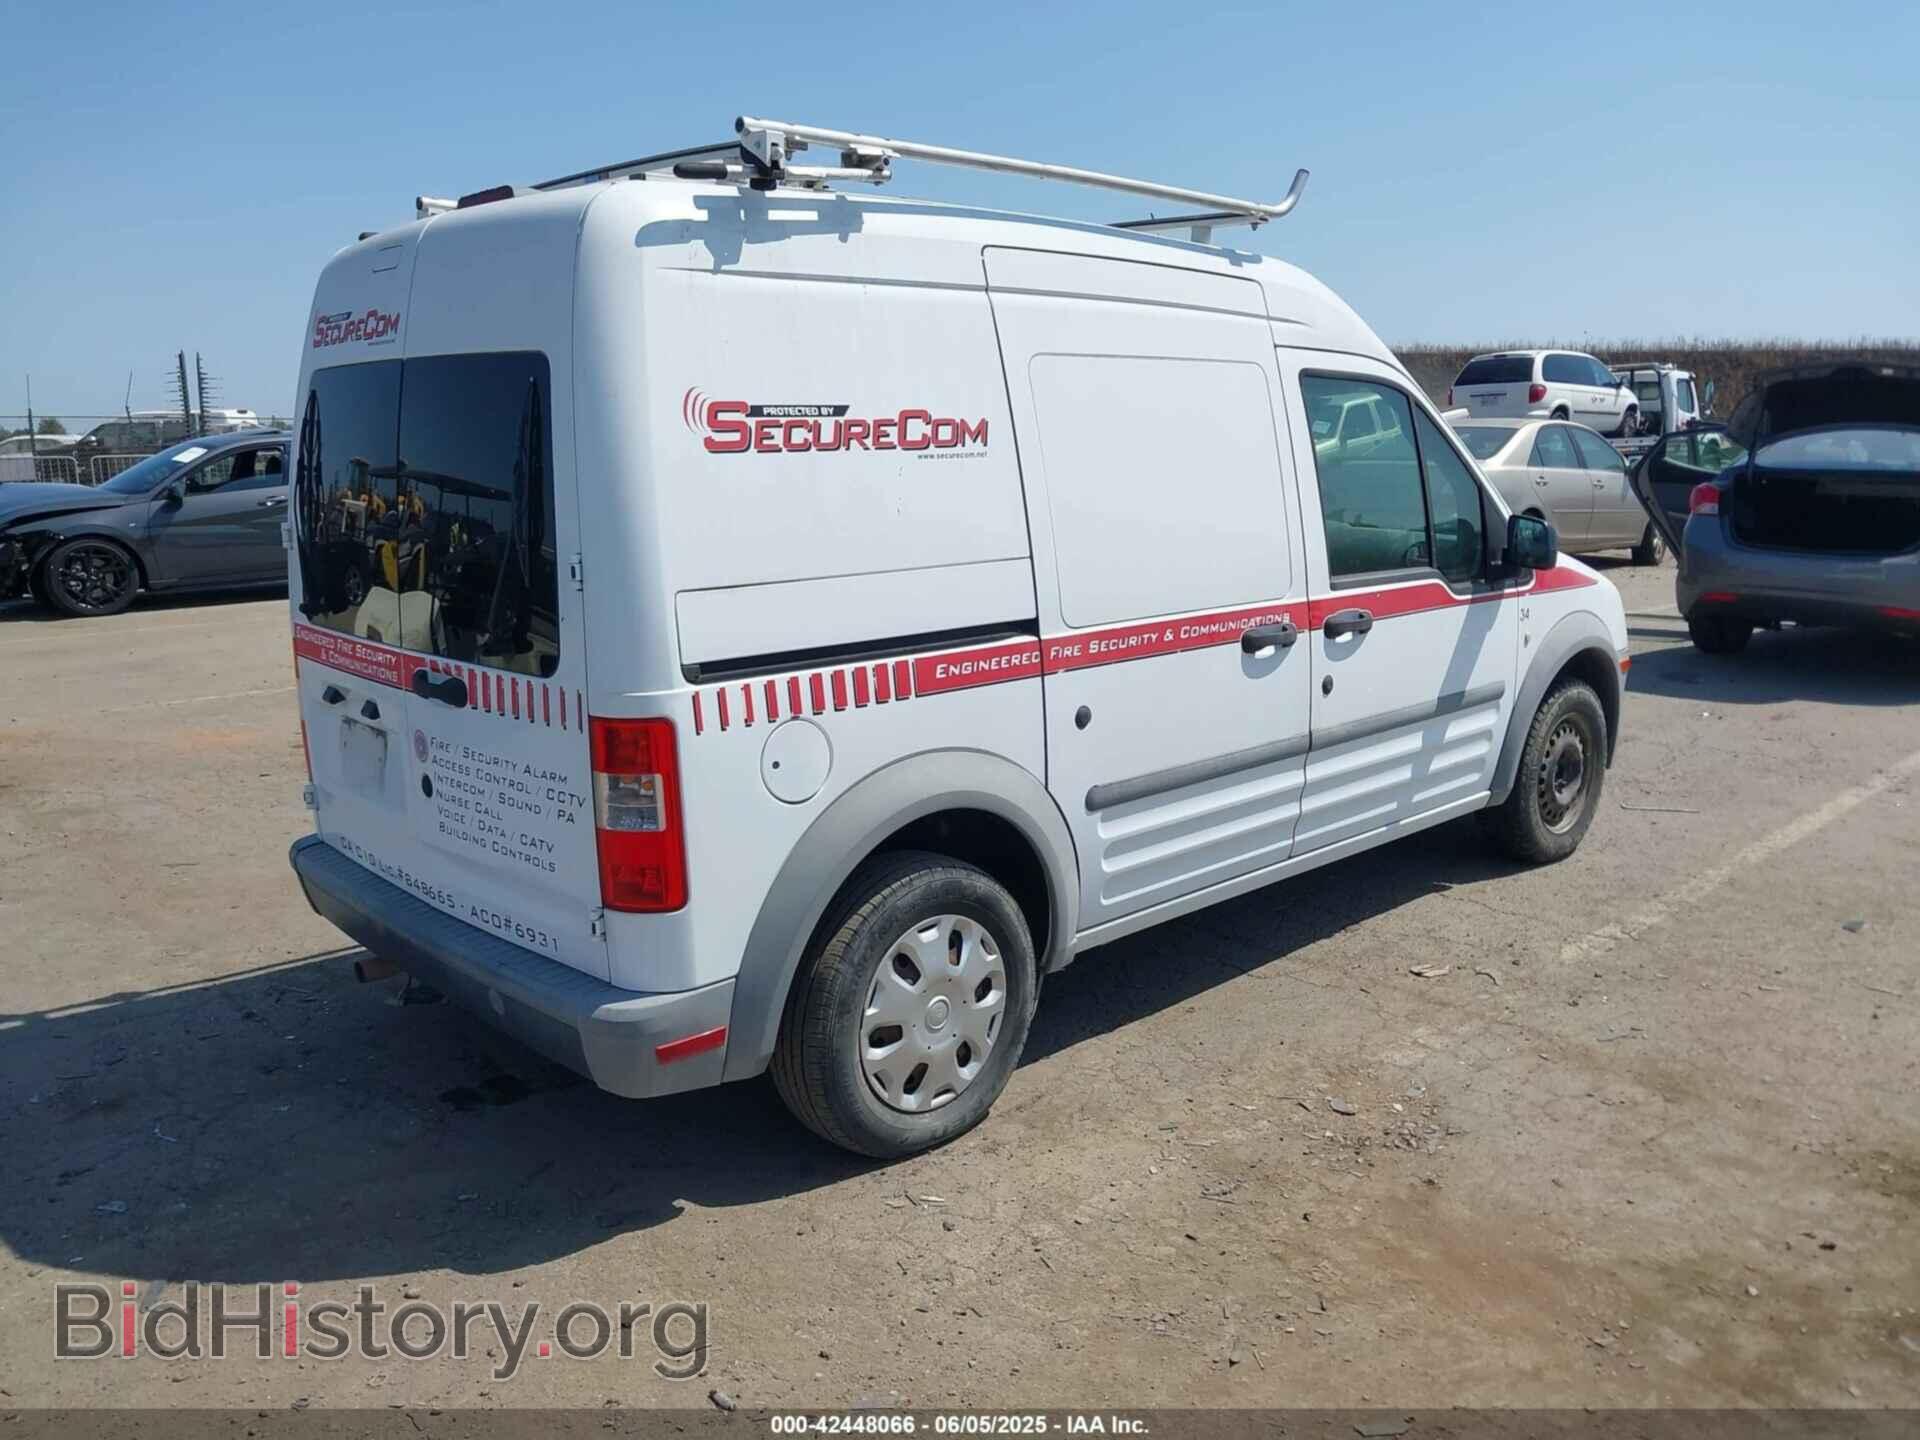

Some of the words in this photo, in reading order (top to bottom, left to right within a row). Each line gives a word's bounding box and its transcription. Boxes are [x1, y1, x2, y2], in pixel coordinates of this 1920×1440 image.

[704, 400, 989, 452] SECURECOM
[763, 405, 819, 416] PROTECTED
[821, 405, 834, 416] BY
[917, 451, 988, 460] www.securecom.net
[337, 639, 353, 655] FIRE
[356, 644, 397, 665] SECURITY
[935, 651, 1041, 678] ENGINEERED
[1051, 645, 1081, 660] FIRE
[1089, 633, 1157, 653] SECURITY
[1163, 630, 1174, 641] &
[1180, 613, 1290, 639] COMMUNICATIONS
[430, 737, 451, 753] FIRE
[463, 747, 517, 772] SECURITY
[523, 765, 567, 784] ALARM
[432, 755, 471, 776] ACCESS
[476, 768, 531, 794] CONTROL
[546, 788, 586, 808] CCTV
[434, 771, 485, 796] INTERCOM
[499, 793, 541, 815] SOUND
[557, 810, 575, 824] PA
[436, 788, 470, 810] NURSE
[475, 802, 503, 820] CALL
[437, 805, 466, 825] VOICE
[478, 820, 506, 838] DATA
[520, 833, 554, 853] CATV
[439, 822, 487, 848] BUILDING
[492, 841, 556, 873] CONTROLS
[471, 905, 559, 952] ACO#6931
